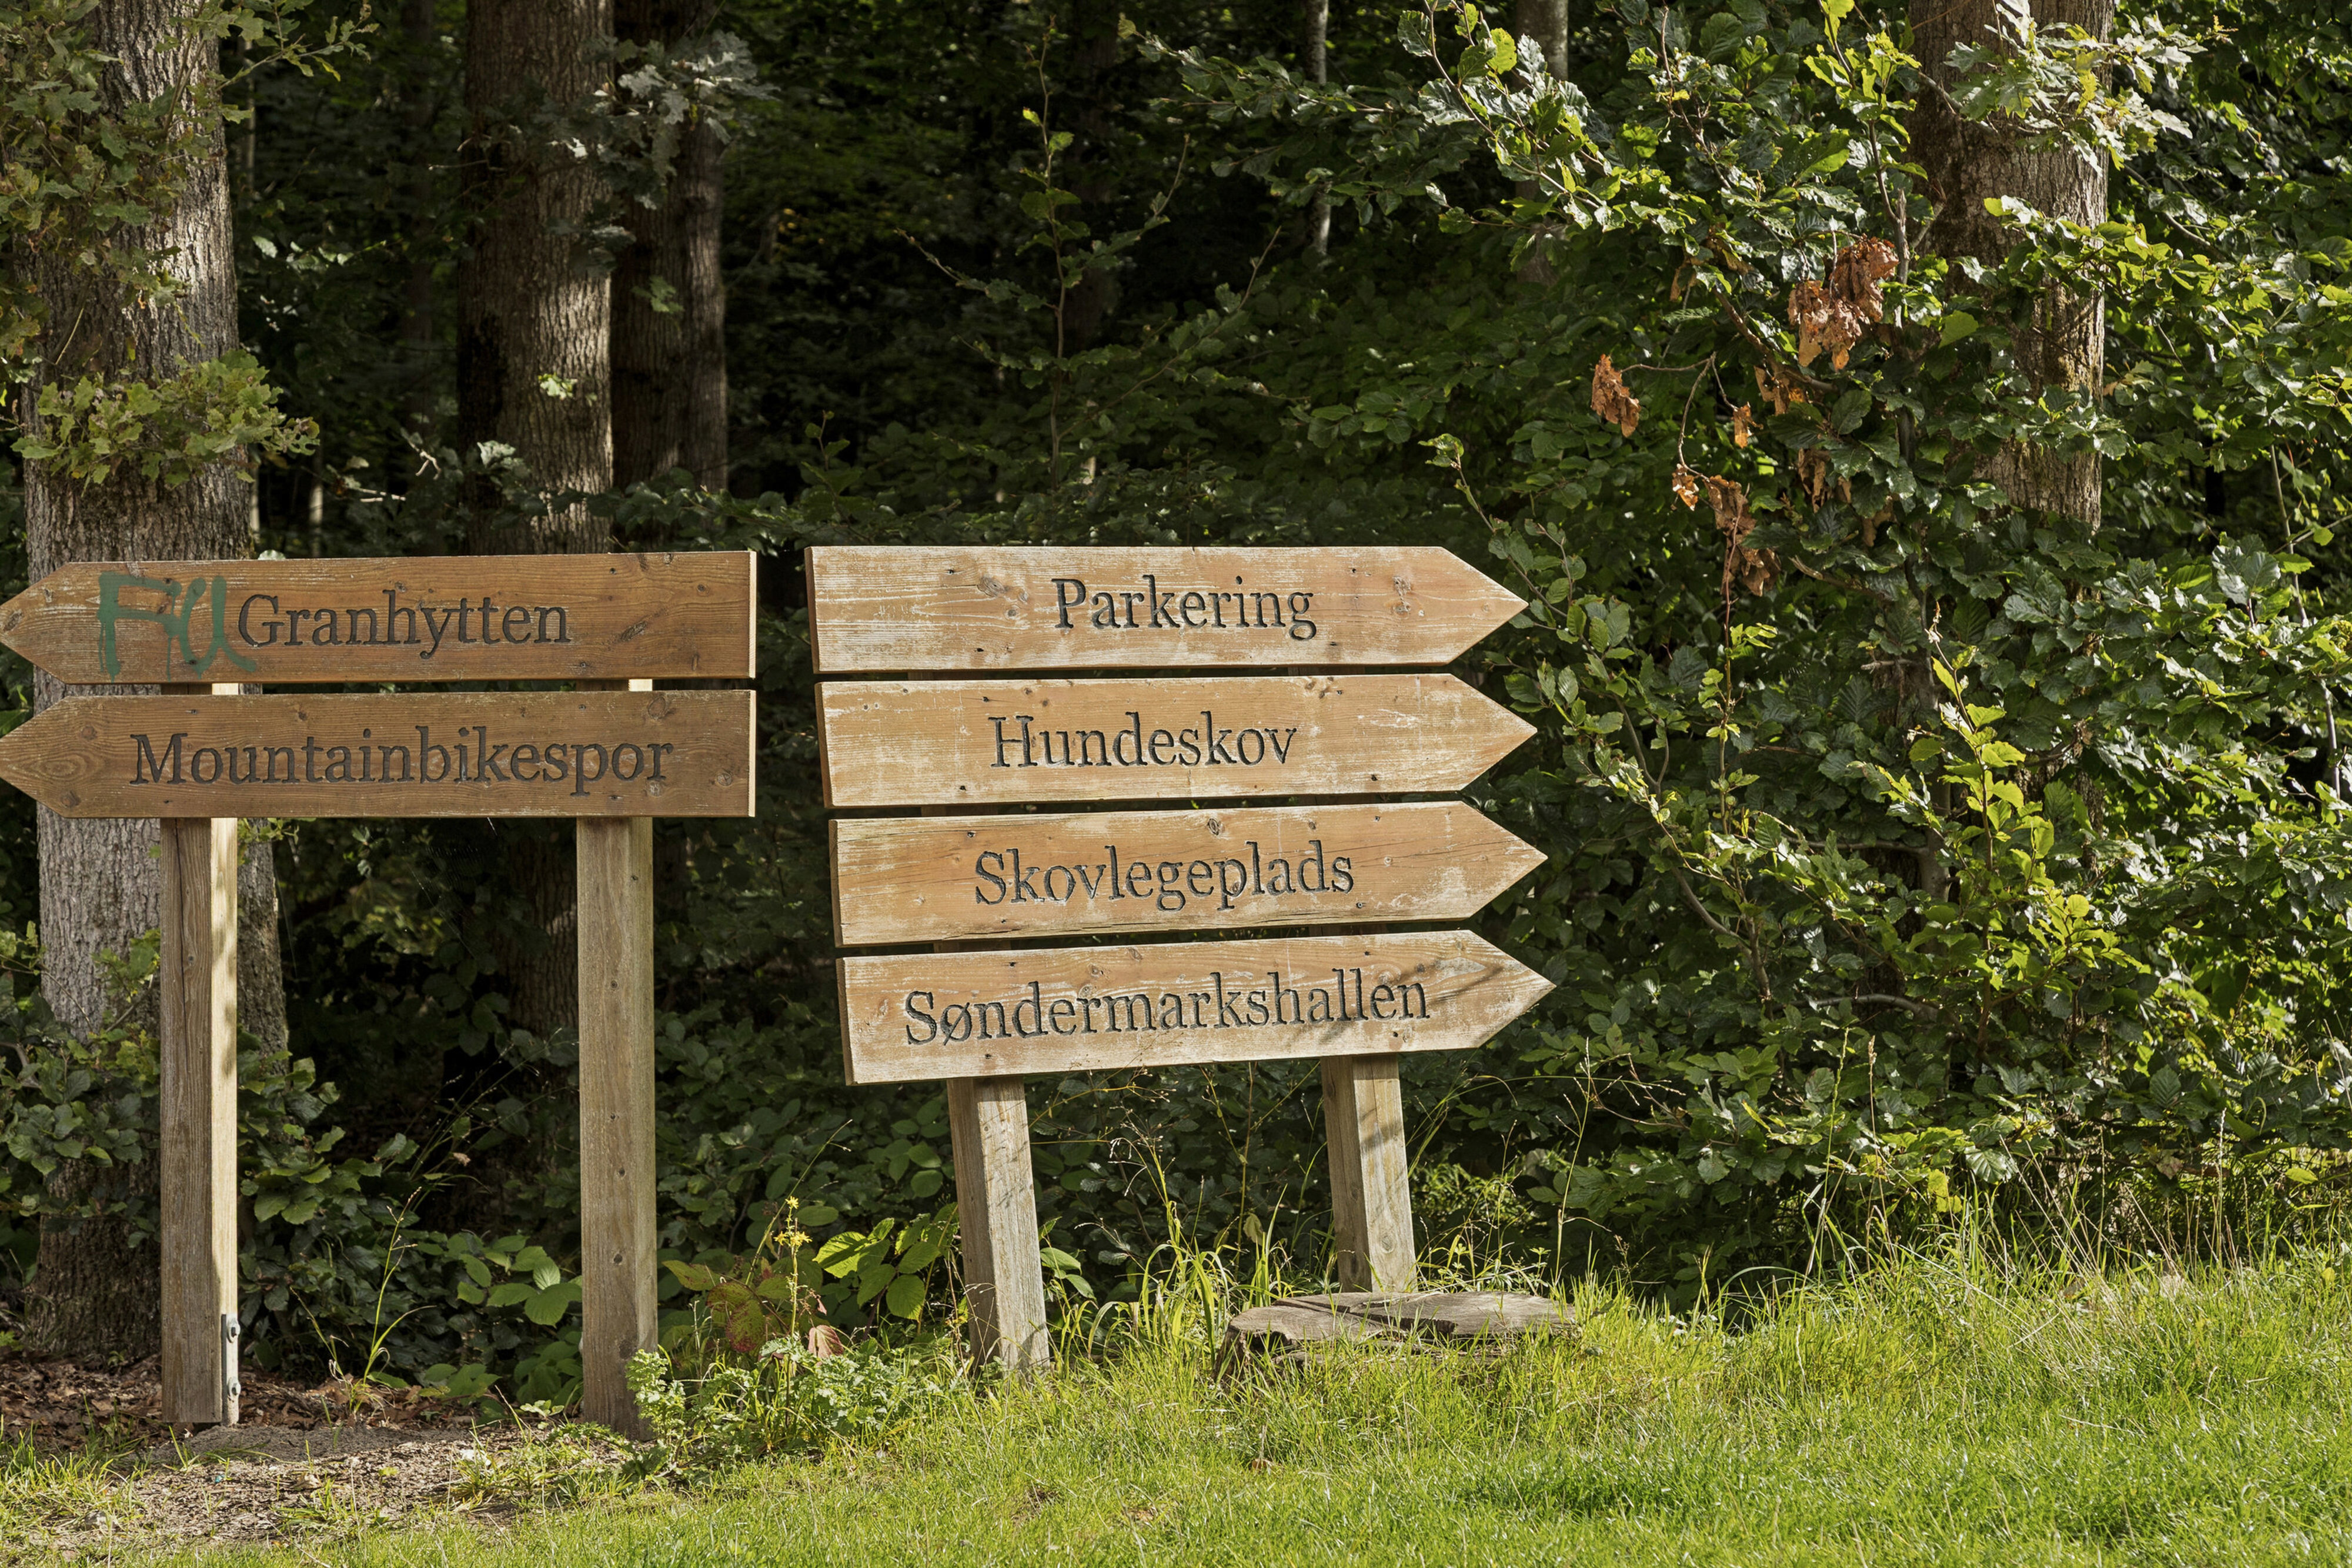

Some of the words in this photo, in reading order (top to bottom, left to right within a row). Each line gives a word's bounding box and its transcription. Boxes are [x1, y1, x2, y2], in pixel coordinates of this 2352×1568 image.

[238, 589, 571, 658] Granhytten
[1051, 574, 1317, 641] Parkering
[129, 725, 673, 796] Mountainbikespor
[988, 711, 1297, 768] Hundeskov
[975, 840, 1354, 911] Skovlegeplads
[906, 968, 1431, 1046] Søndermarkshallen
